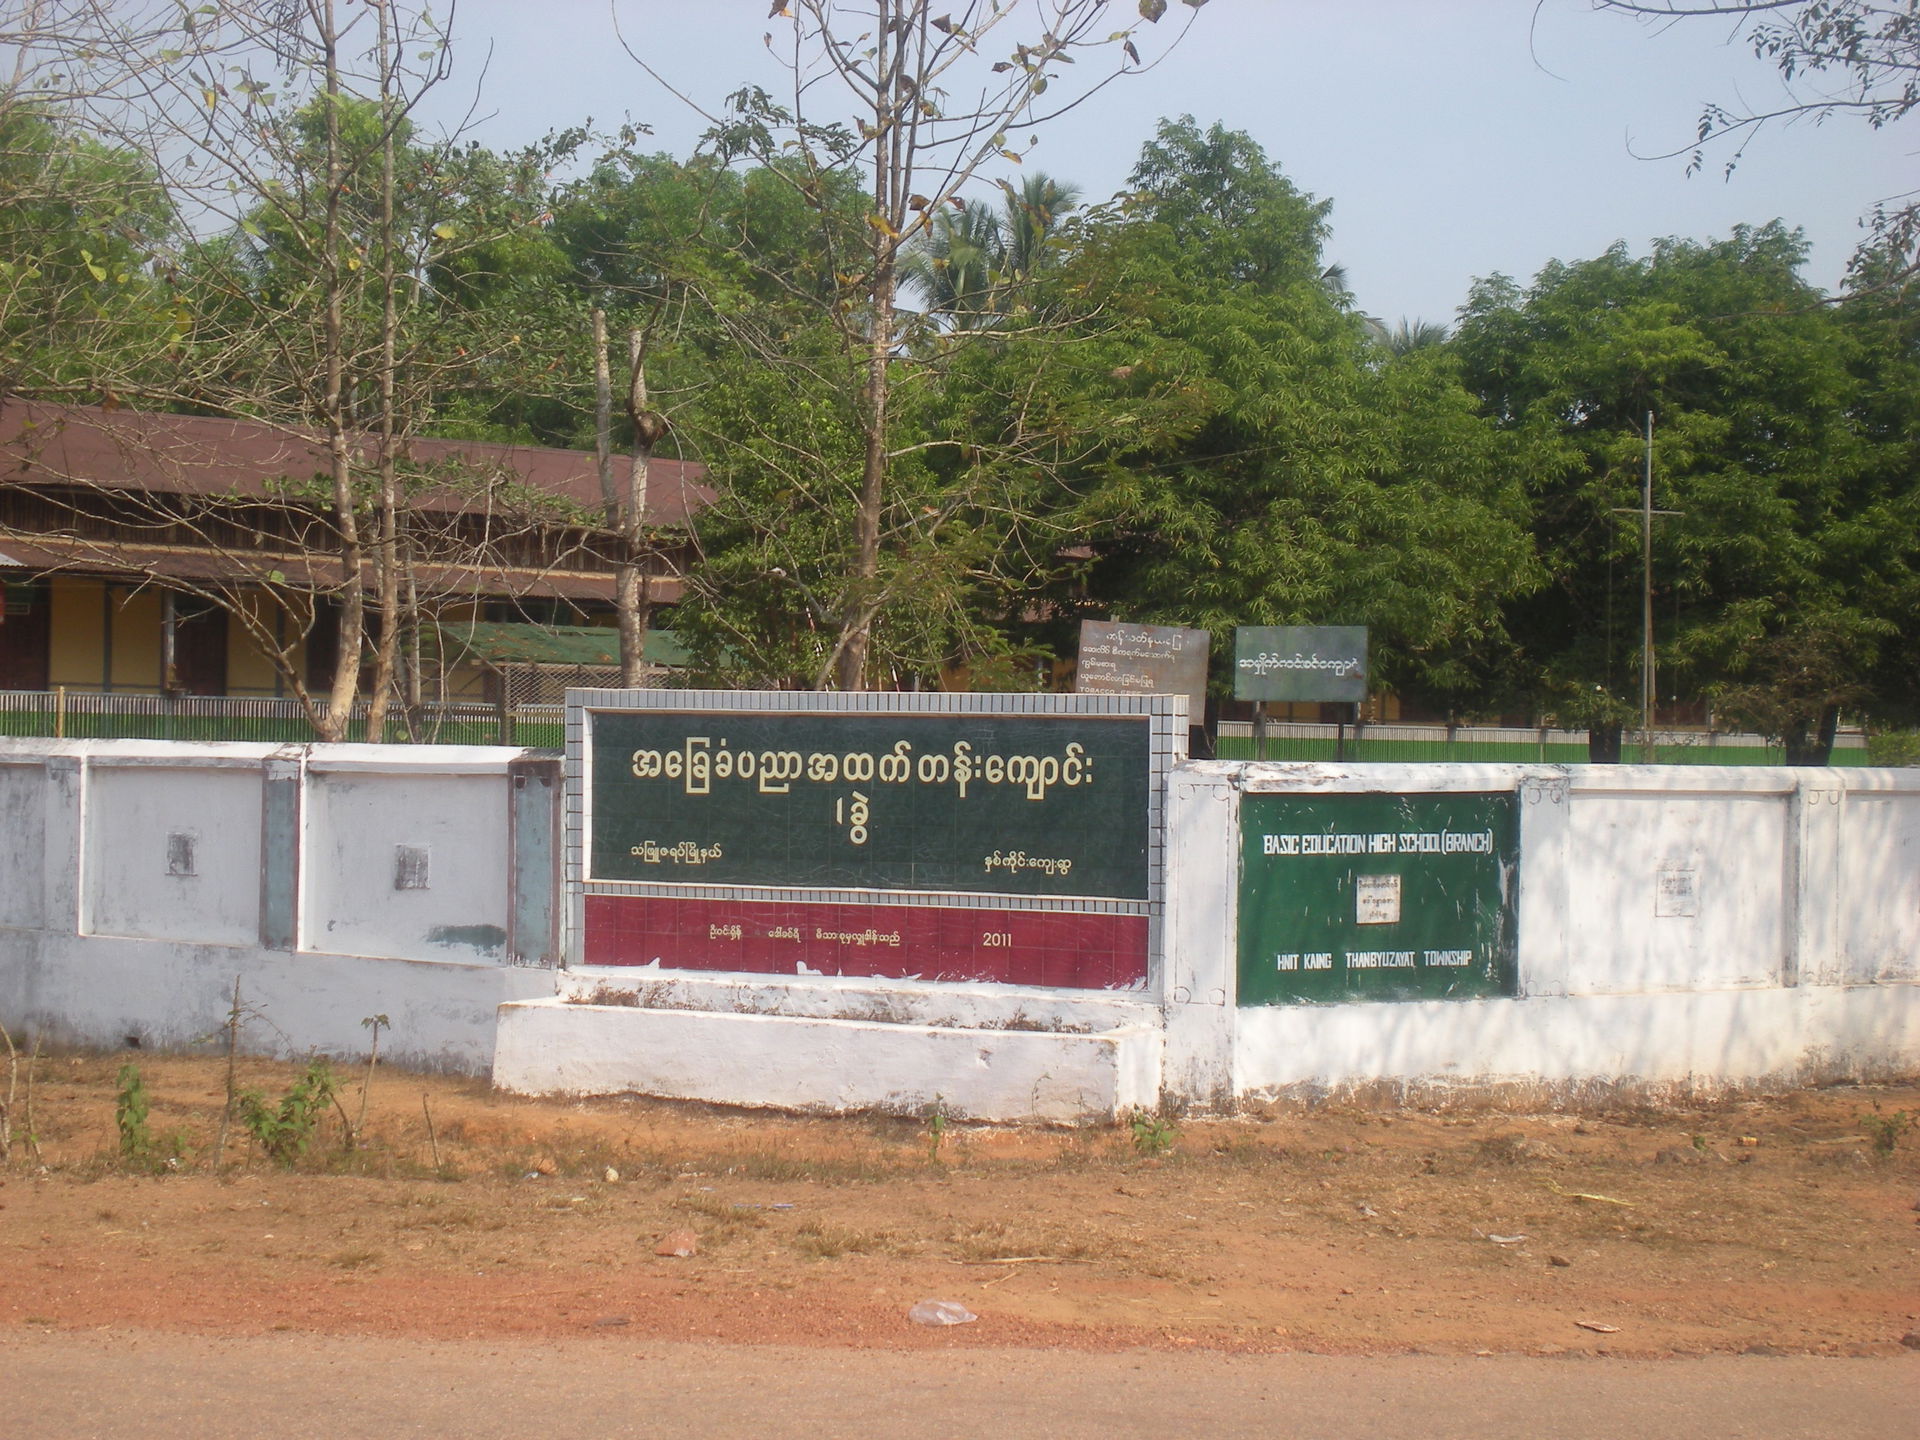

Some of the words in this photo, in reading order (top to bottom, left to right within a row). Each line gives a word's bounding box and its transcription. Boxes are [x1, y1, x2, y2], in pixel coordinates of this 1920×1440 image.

[631, 737, 1094, 800] အခြေခံပညာအထက်တန်းကျောင်း
[1263, 834, 1300, 855] BASIC
[1302, 833, 1367, 854] EDUCATION
[1368, 833, 1397, 854] HIGH
[983, 932, 1012, 947] 2011
[1277, 954, 1300, 970] HNIT
[1304, 952, 1333, 970] KAING
[1345, 951, 1416, 969] THANBYUZAYAT
[1423, 949, 1473, 967] TOWNSHIP
